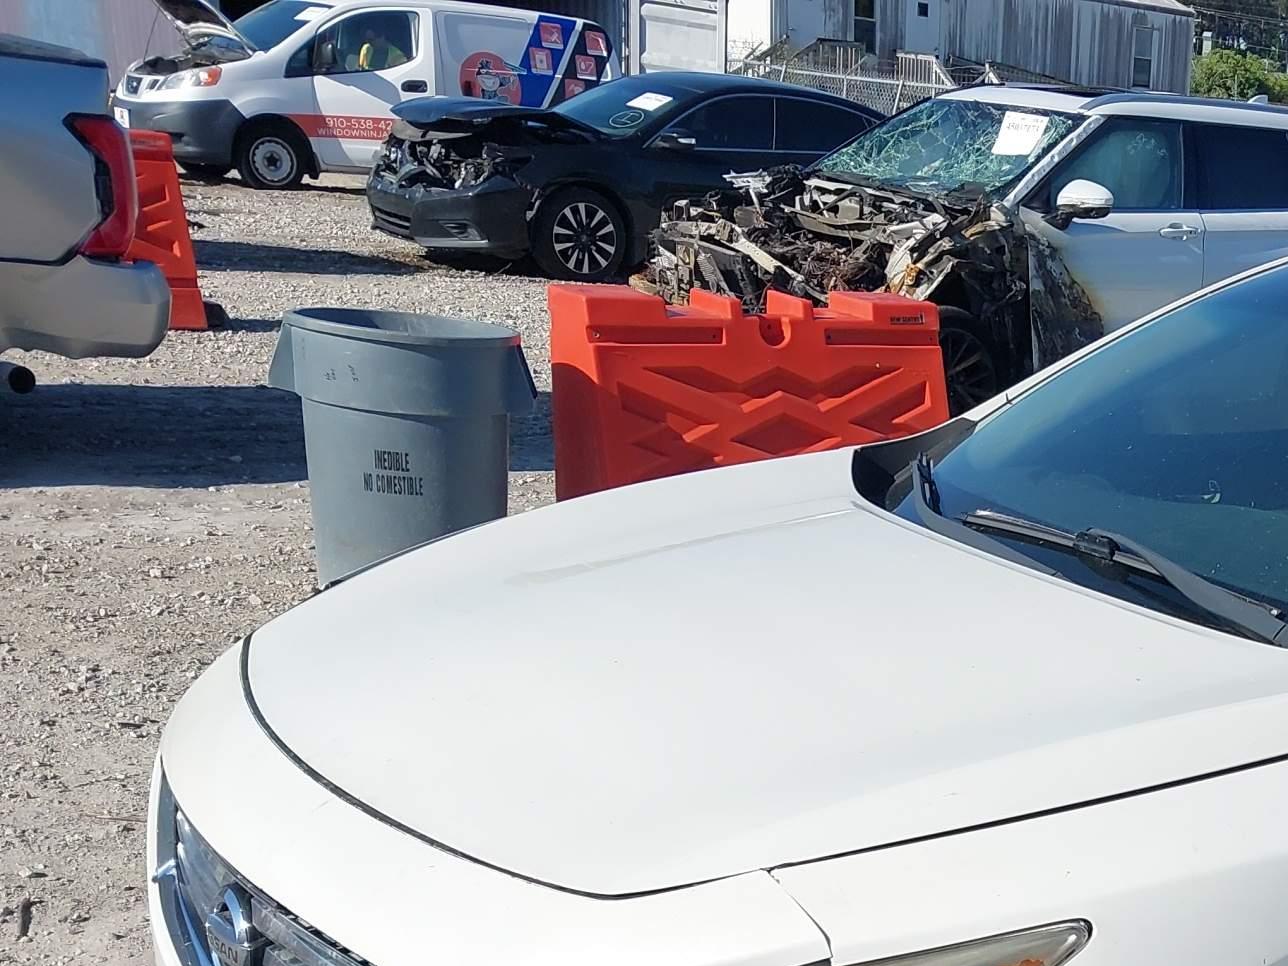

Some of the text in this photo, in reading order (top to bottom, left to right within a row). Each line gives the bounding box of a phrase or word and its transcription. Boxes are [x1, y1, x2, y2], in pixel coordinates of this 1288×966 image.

[374, 449, 410, 473] INEDIBLE
[363, 472, 424, 497] NO COMESTIBLE
